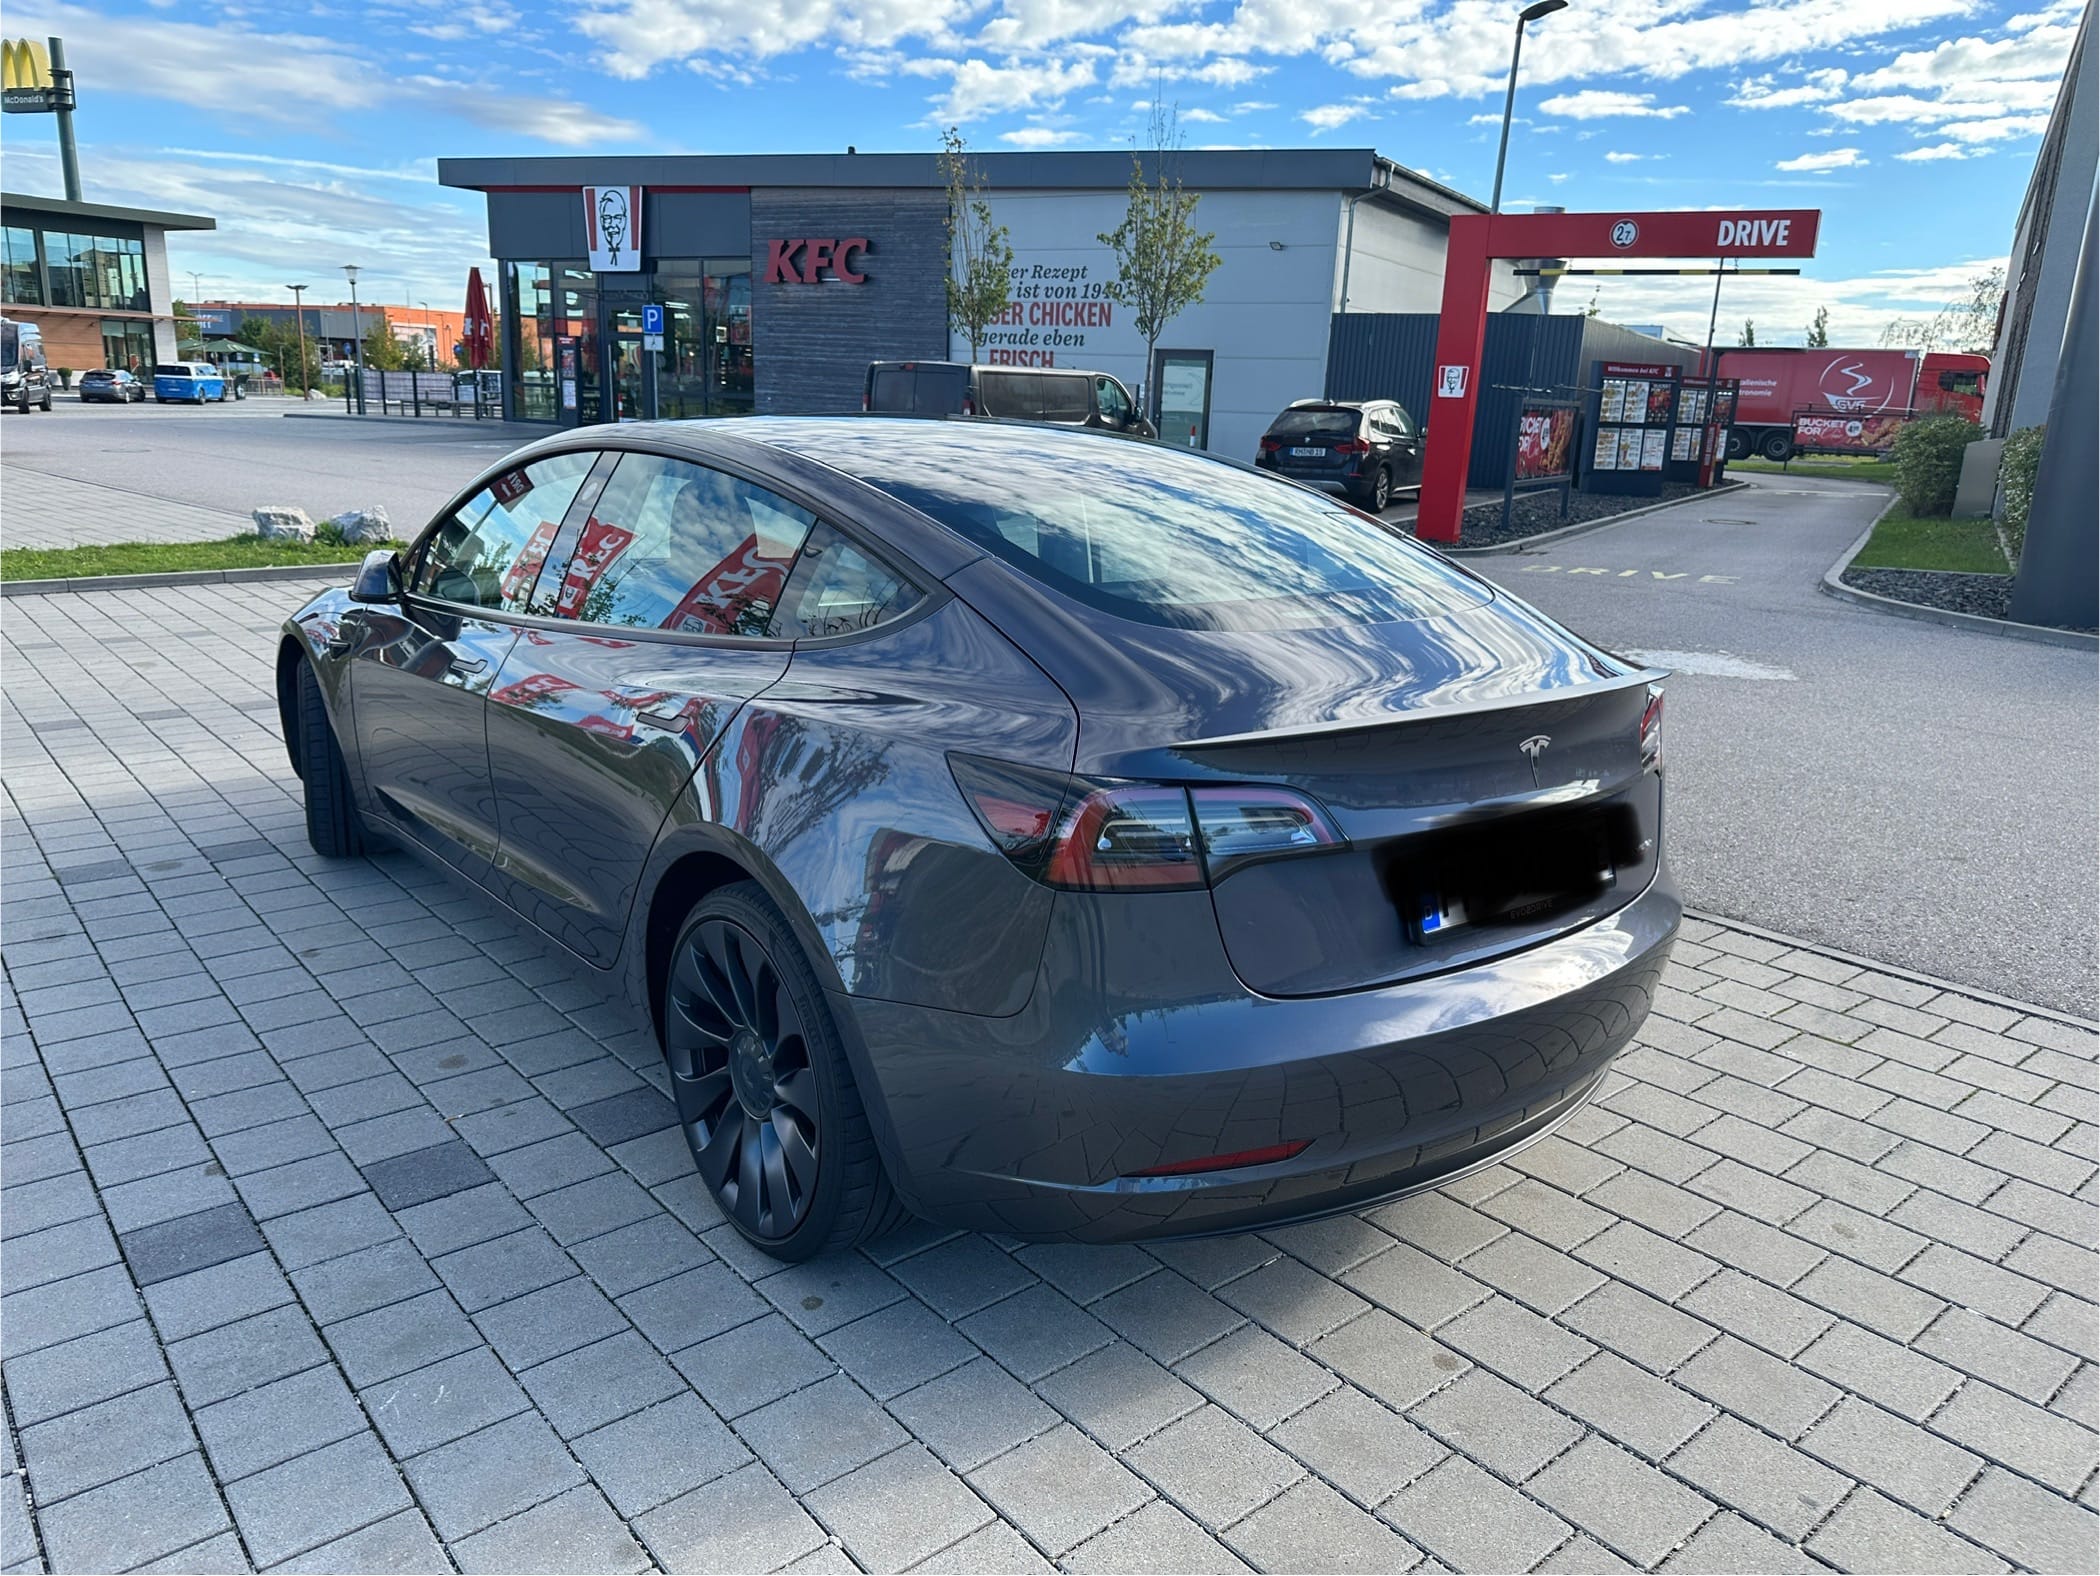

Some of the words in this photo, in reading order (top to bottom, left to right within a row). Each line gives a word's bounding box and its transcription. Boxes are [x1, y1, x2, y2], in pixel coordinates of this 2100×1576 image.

[4, 95, 44, 104] McDonald's
[1716, 219, 1791, 247] DRIVE
[763, 237, 868, 284] KFC
[1031, 265, 1088, 282] Rezept
[1017, 281, 1040, 298] ist
[1044, 286, 1077, 299] von
[647, 309, 658, 330] P
[1029, 301, 1112, 327] CHICKEN
[980, 328, 1038, 347] gerade
[1043, 329, 1085, 347] eben
[989, 349, 1054, 368] FRISCH
[1797, 426, 1821, 435] FOR
[1799, 418, 1847, 429] BUCKET
[1520, 565, 1741, 585] DRIVE
